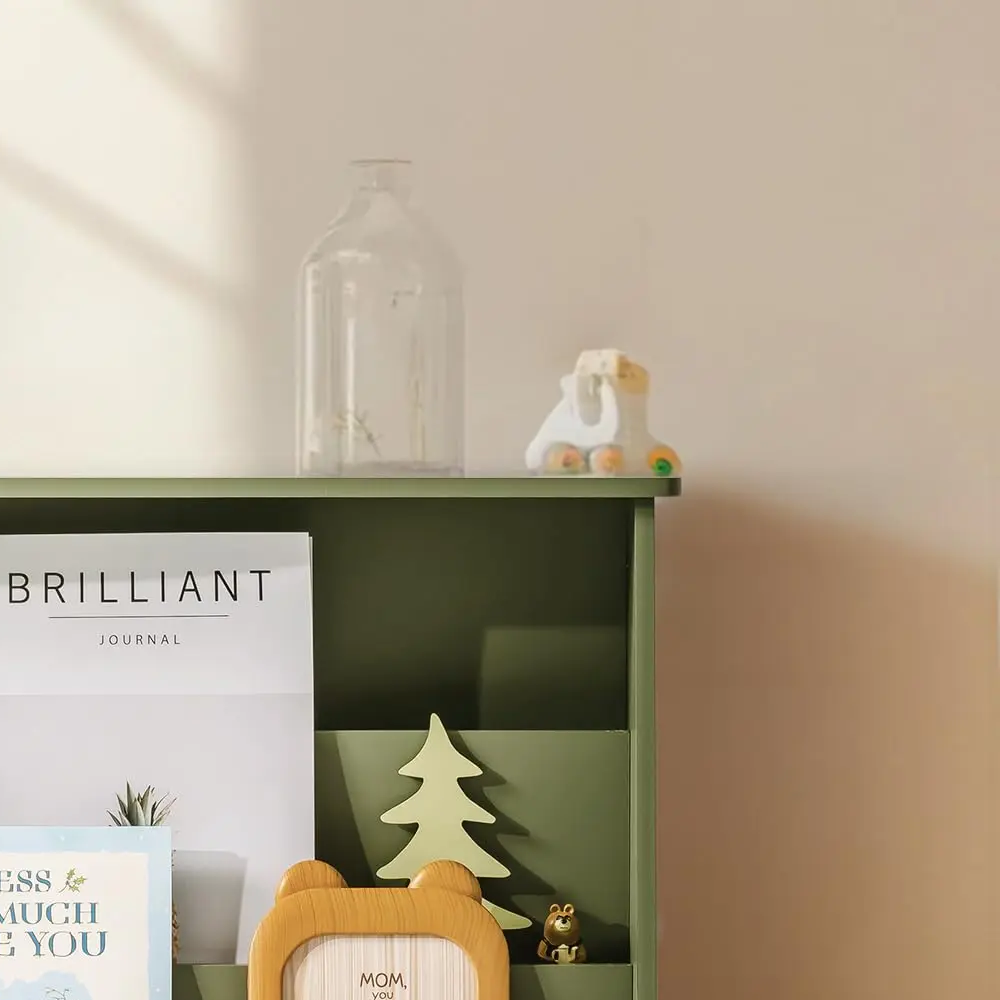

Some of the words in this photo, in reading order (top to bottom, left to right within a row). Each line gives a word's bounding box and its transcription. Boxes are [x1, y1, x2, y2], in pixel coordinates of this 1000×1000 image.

[8, 570, 271, 604] BRILLIANT
[99, 634, 181, 646] JOURNAL
[25, 931, 108, 958] YOU
[360, 972, 407, 990] MOM,
